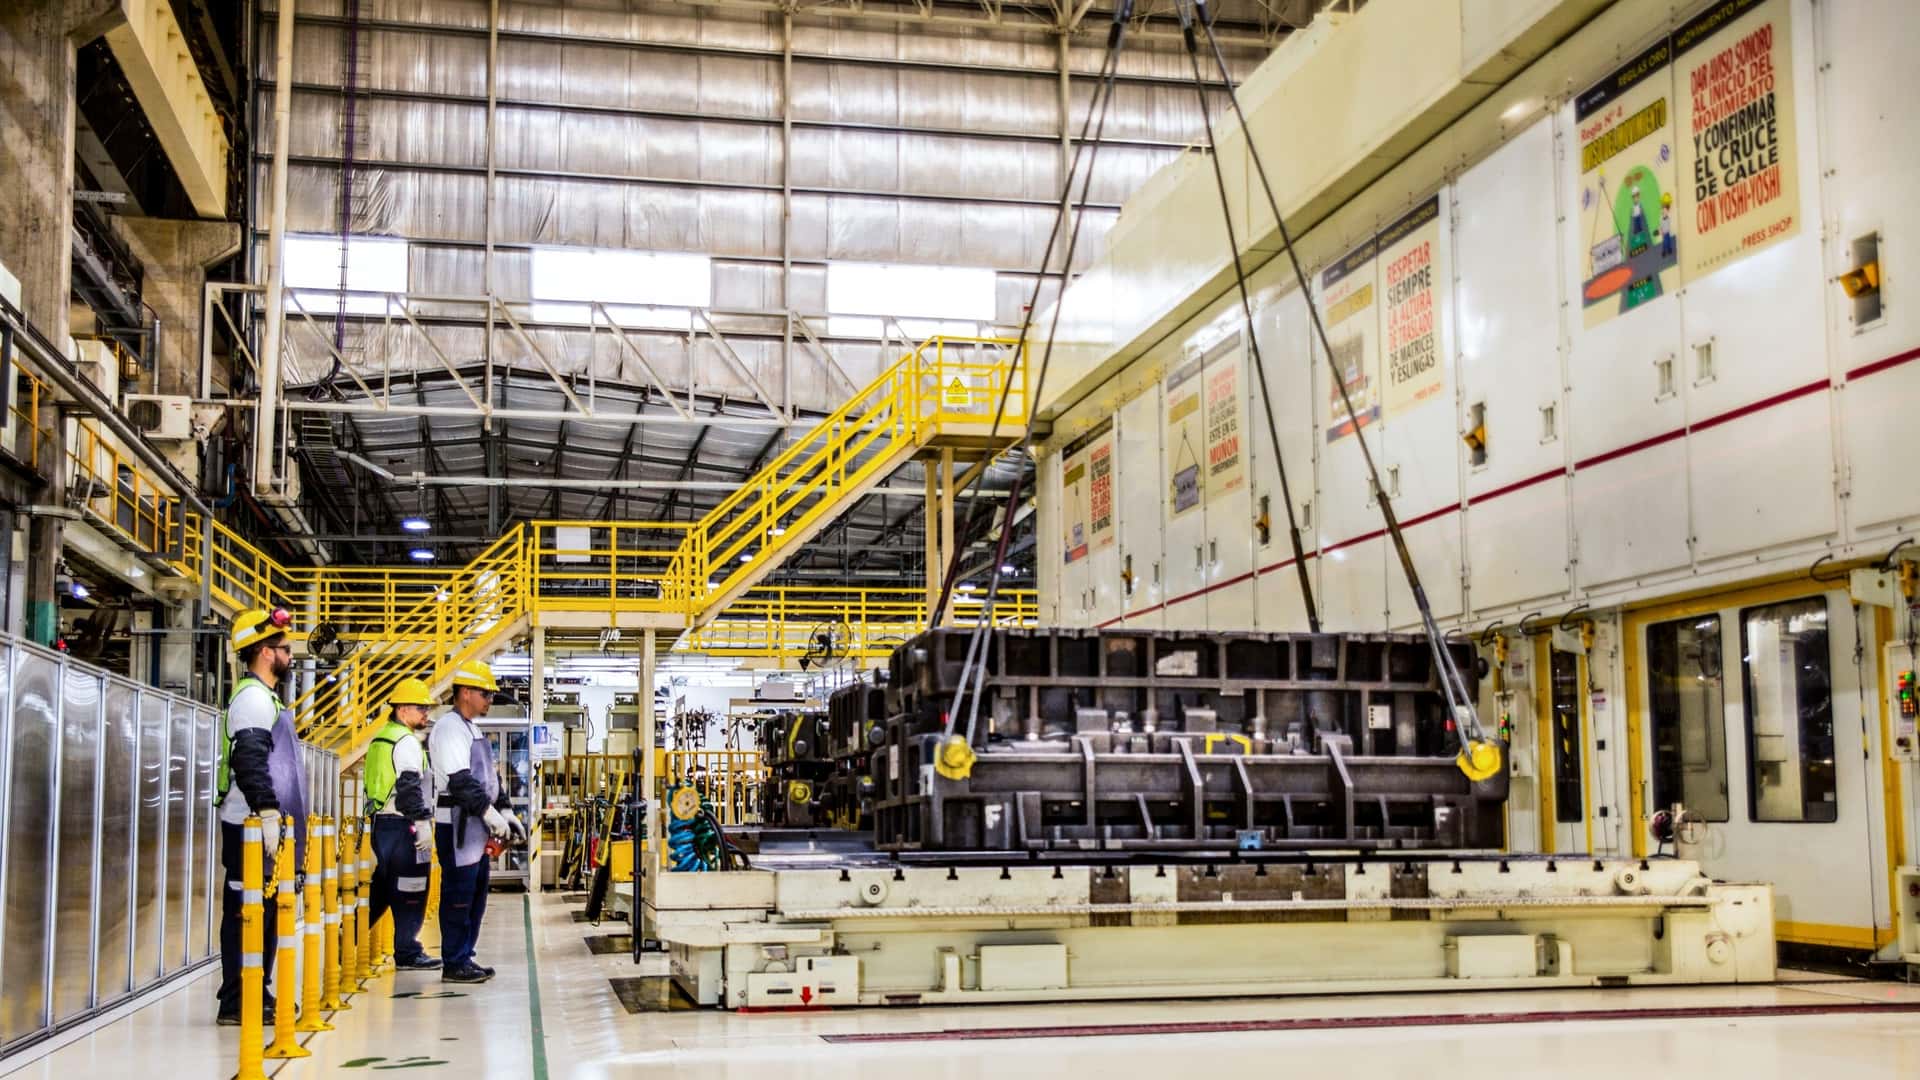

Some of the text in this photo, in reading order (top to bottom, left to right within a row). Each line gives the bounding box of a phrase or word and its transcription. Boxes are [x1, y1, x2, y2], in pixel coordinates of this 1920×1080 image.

[1691, 23, 1772, 96] DAR AVISO SONORO
[1693, 53, 1773, 112] AL INICIO DEL
[1692, 74, 1774, 133] MOVIMIENTO
[1694, 135, 1701, 157] Y
[1704, 92, 1776, 152] CONFIRMAR
[1695, 119, 1778, 184] EL CRUCE
[1696, 146, 1778, 203] DE CALLE
[1696, 165, 1781, 234] CON YOSHI-YOSHI
[1742, 216, 1793, 249] PRESS SHOP
[1387, 241, 1431, 285] RESPETAR
[1387, 264, 1431, 309] SIEMPRE
[1390, 351, 1435, 387] Y ESLINGAS
